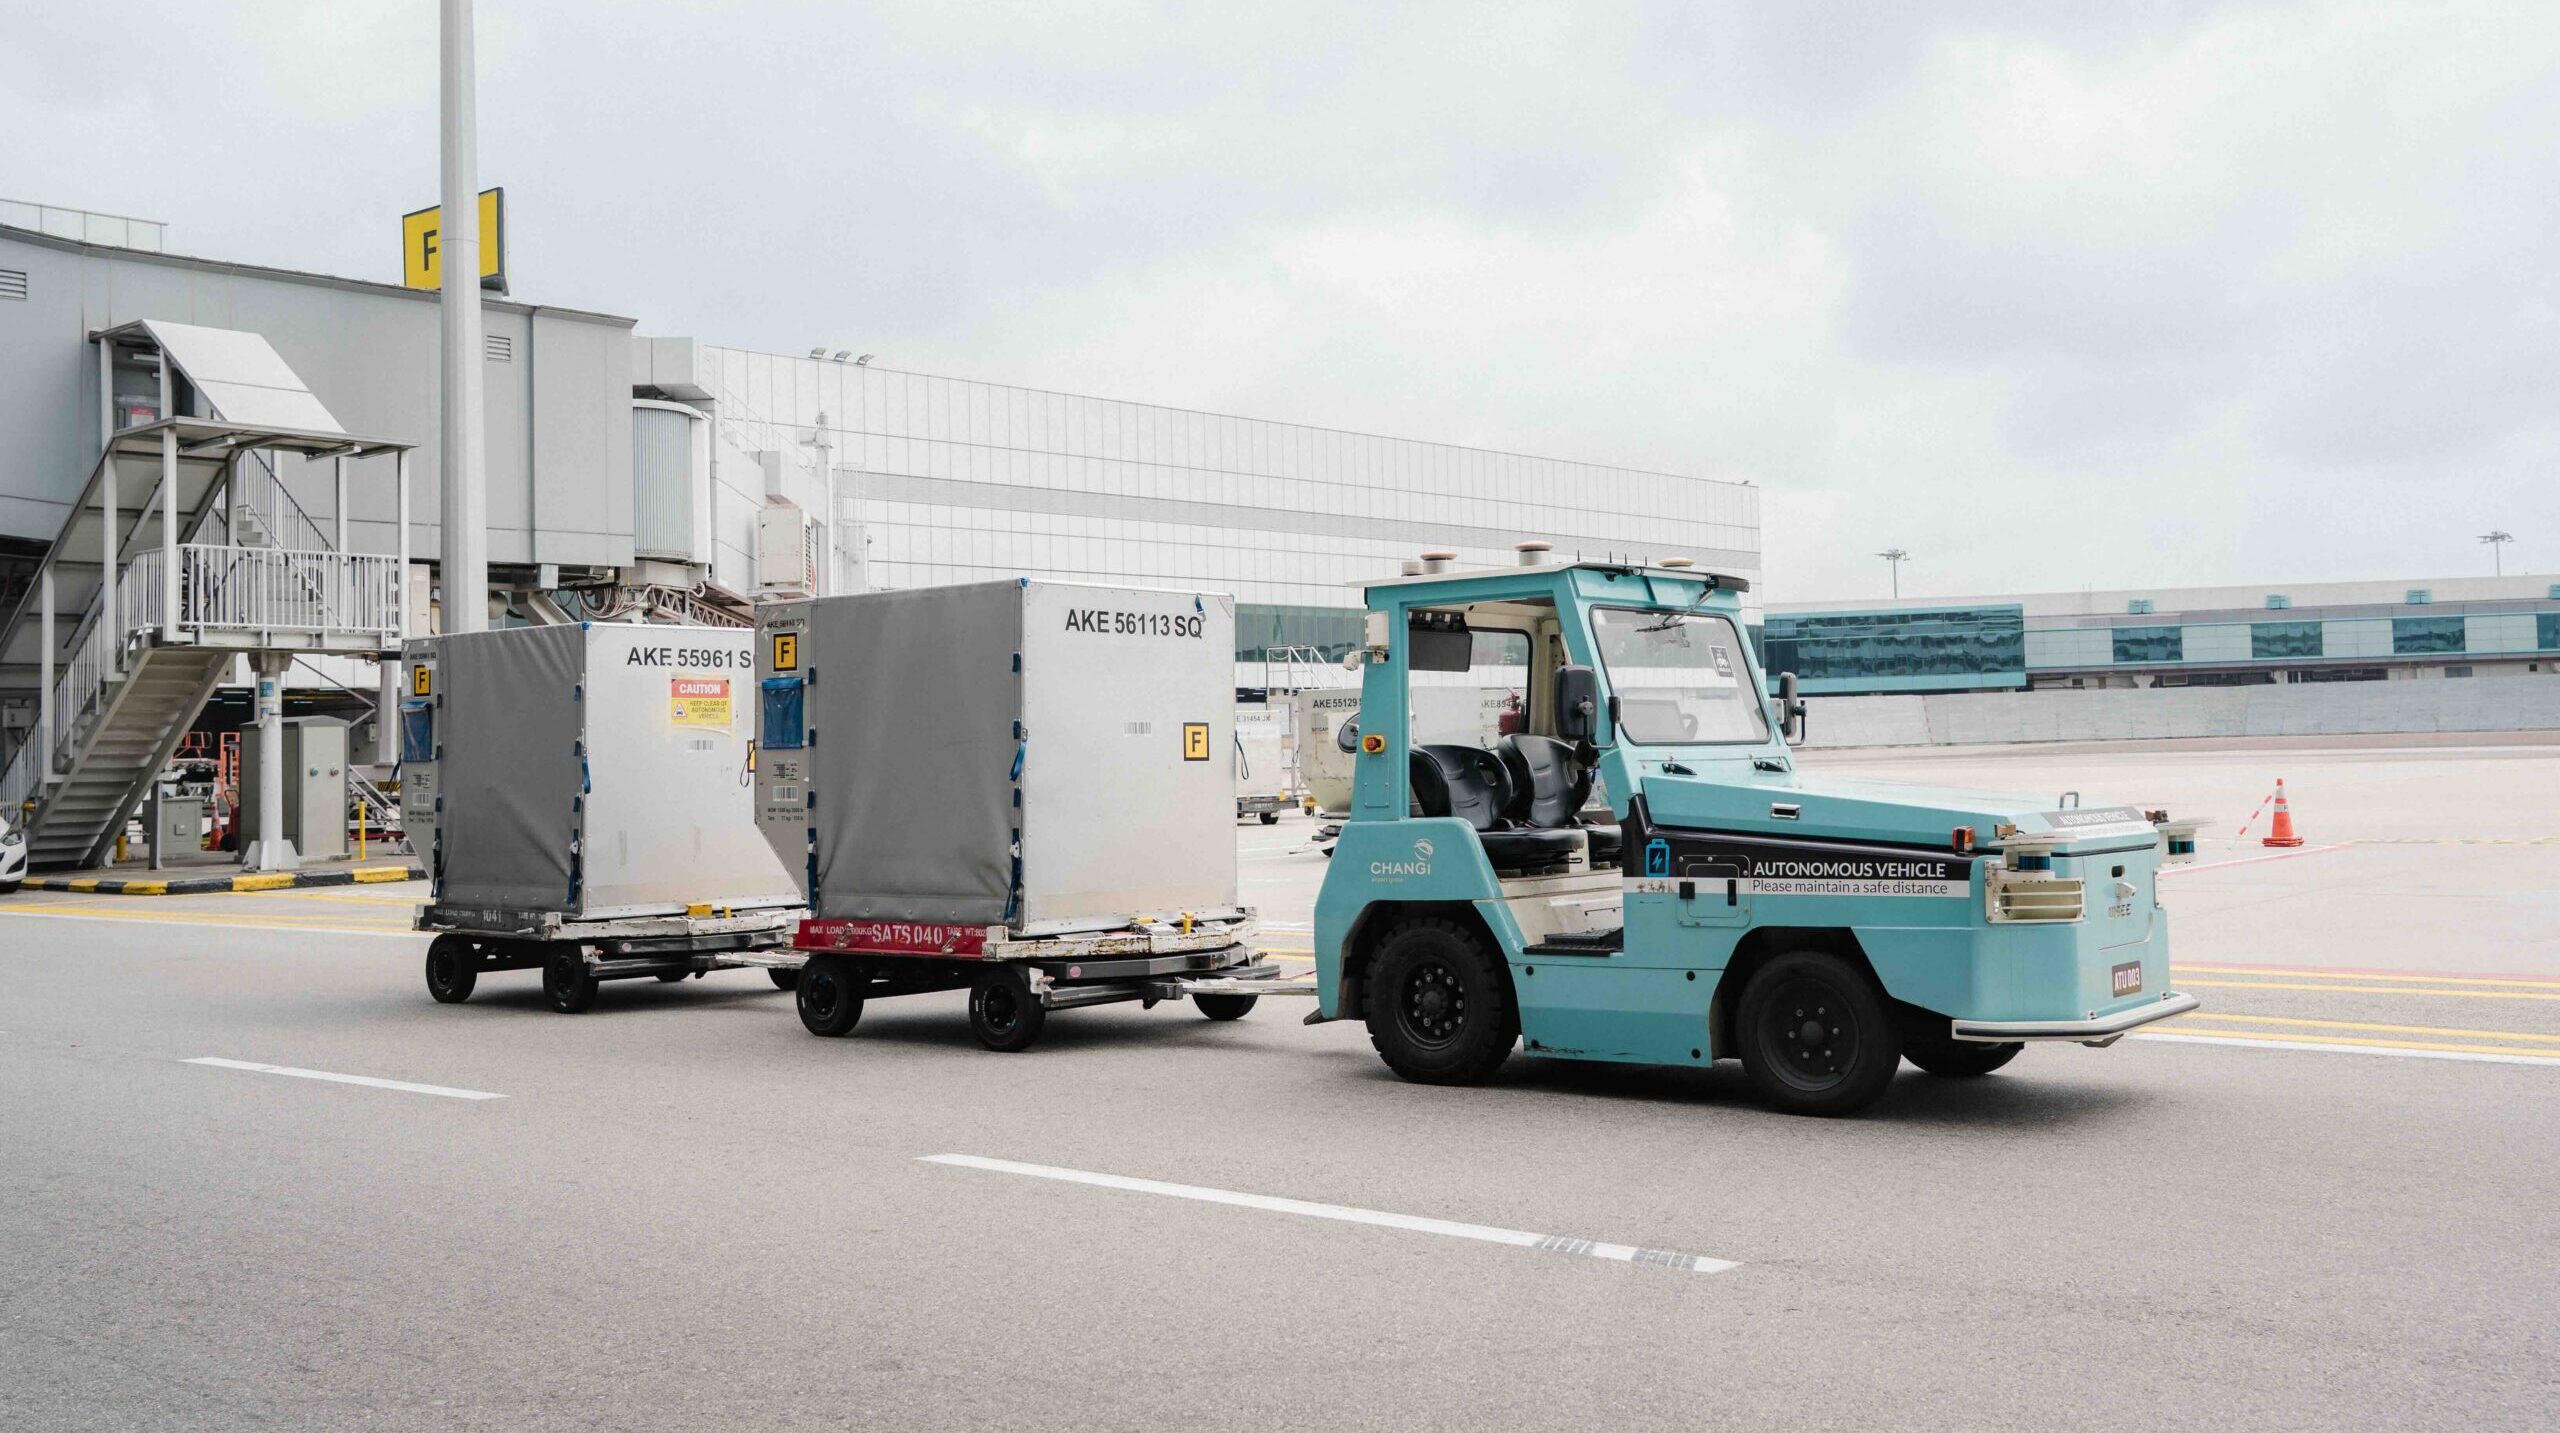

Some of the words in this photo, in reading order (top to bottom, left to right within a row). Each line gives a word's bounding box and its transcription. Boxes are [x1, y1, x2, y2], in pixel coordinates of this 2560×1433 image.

[423, 229, 437, 271] F
[1065, 608, 1110, 633] AKE
[1115, 612, 1170, 636] 56113
[1174, 615, 1202, 639] SQ
[627, 646, 672, 666] AKE
[677, 648, 732, 668] 55961
[739, 650, 755, 668] S
[781, 641, 790, 663] F
[419, 671, 426, 689] F
[679, 683, 721, 695] CAUTION
[1312, 699, 1331, 708] AKE
[1332, 697, 1358, 708] 55129
[1191, 731, 1202, 753] F
[1370, 862, 1431, 875] CHANGI
[1754, 862, 1873, 877] AUTONOMOUS
[1875, 862, 1947, 878] VEHICLE
[1752, 879, 1793, 892] Please
[1795, 880, 1850, 893] maintain
[1852, 883, 1860, 893] a
[1863, 880, 1890, 894] safe
[1892, 881, 1948, 894] distance
[809, 925, 823, 935] MAX
[826, 926, 844, 935] LOAD
[872, 923, 911, 944] SATS
[914, 925, 943, 945] 040
[2114, 970, 2128, 991] ATU
[2127, 967, 2140, 986] 003
